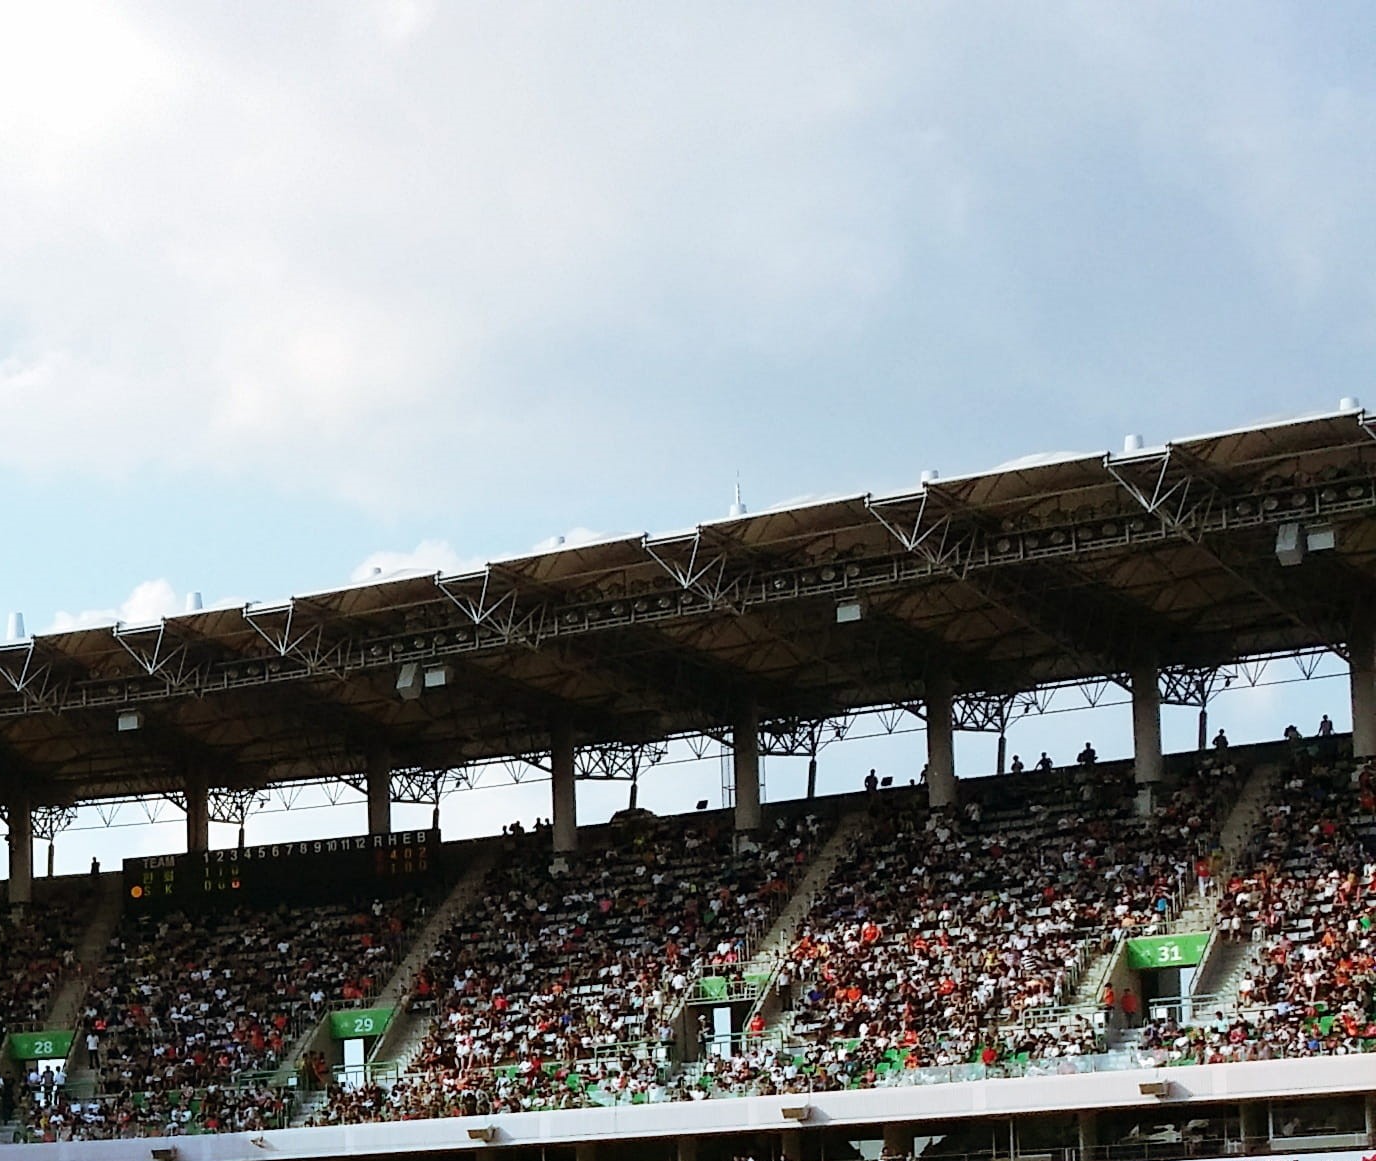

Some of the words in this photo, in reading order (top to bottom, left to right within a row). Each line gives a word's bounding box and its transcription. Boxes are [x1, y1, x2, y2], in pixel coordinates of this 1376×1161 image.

[144, 856, 176, 869] TEAM
[1157, 945, 1181, 964] 31
[354, 1017, 374, 1033] 29
[34, 1041, 52, 1057] 28
